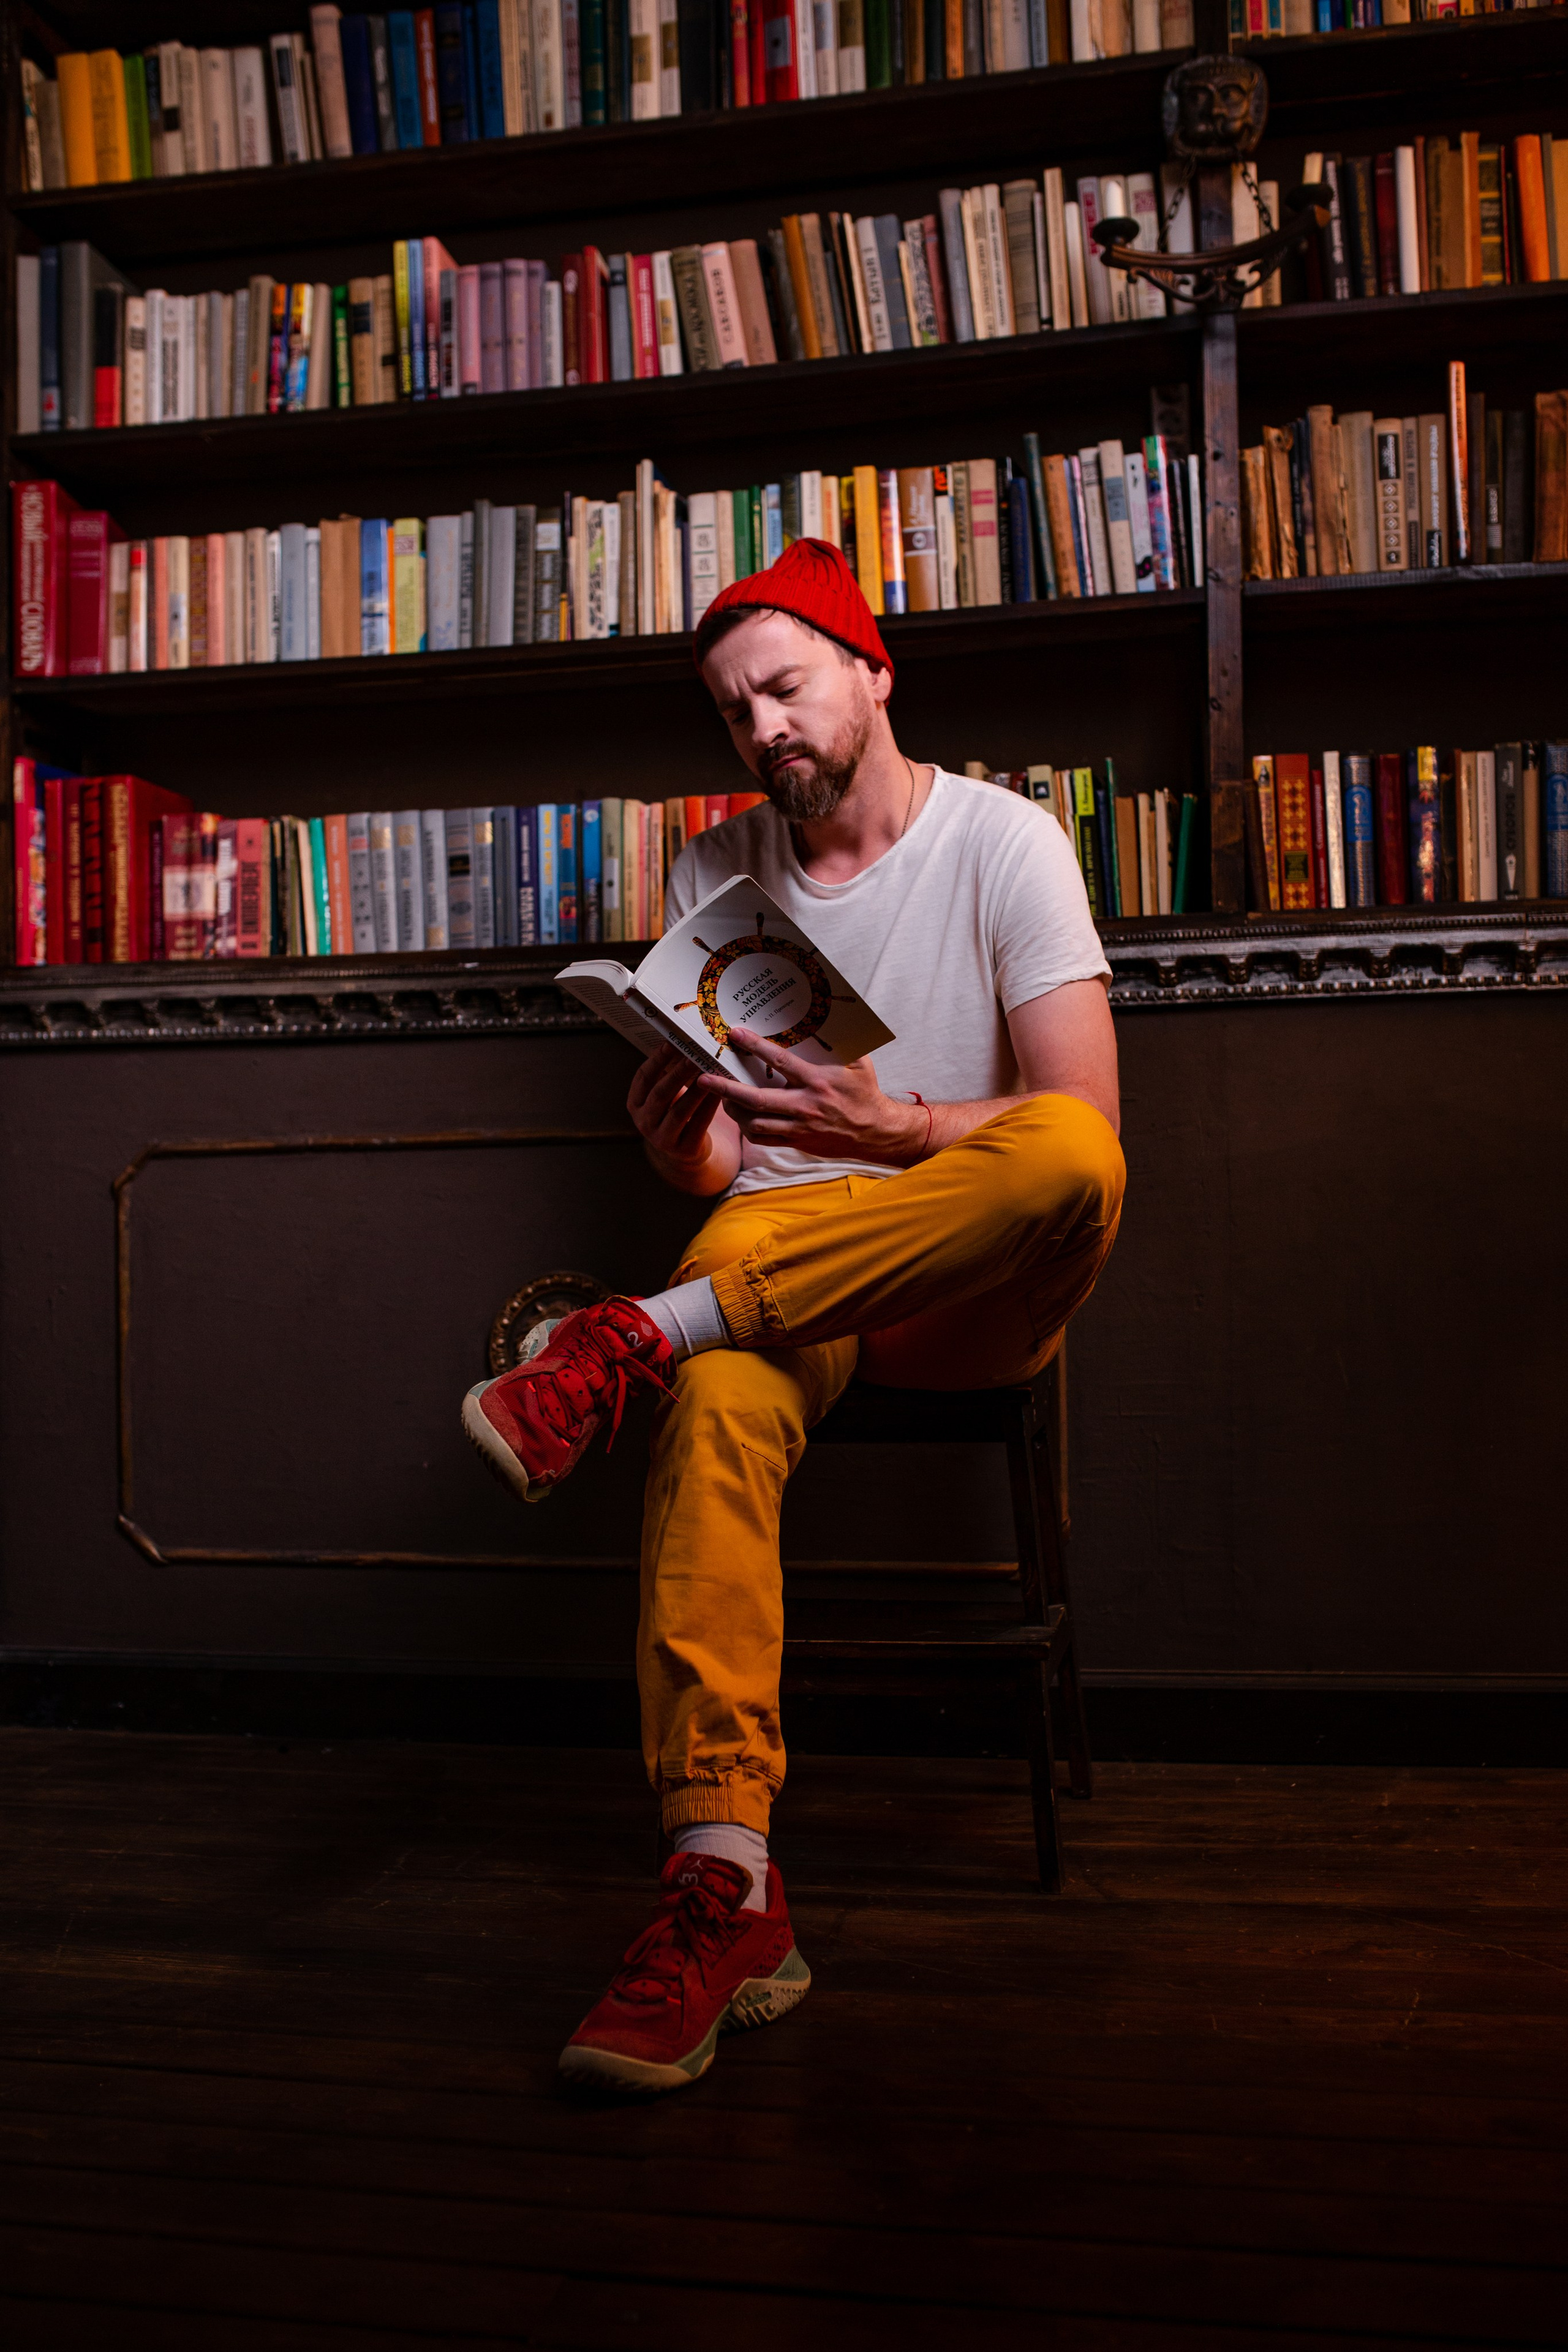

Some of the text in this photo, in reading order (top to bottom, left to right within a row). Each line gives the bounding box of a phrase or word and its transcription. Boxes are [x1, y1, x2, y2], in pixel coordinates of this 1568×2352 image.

[21, 601, 45, 671] СЛОВАРЬ
[732, 968, 773, 1001] РУССКАЯ
[740, 977, 797, 1023] УПРАВЛЕНИЯ
[742, 978, 778, 1007] МОДЕЛЬ
[668, 1031, 719, 1077] СКАЯ МОДЕЛЬ
[688, 1041, 734, 1080] УПРАВЛЕНИЯ
